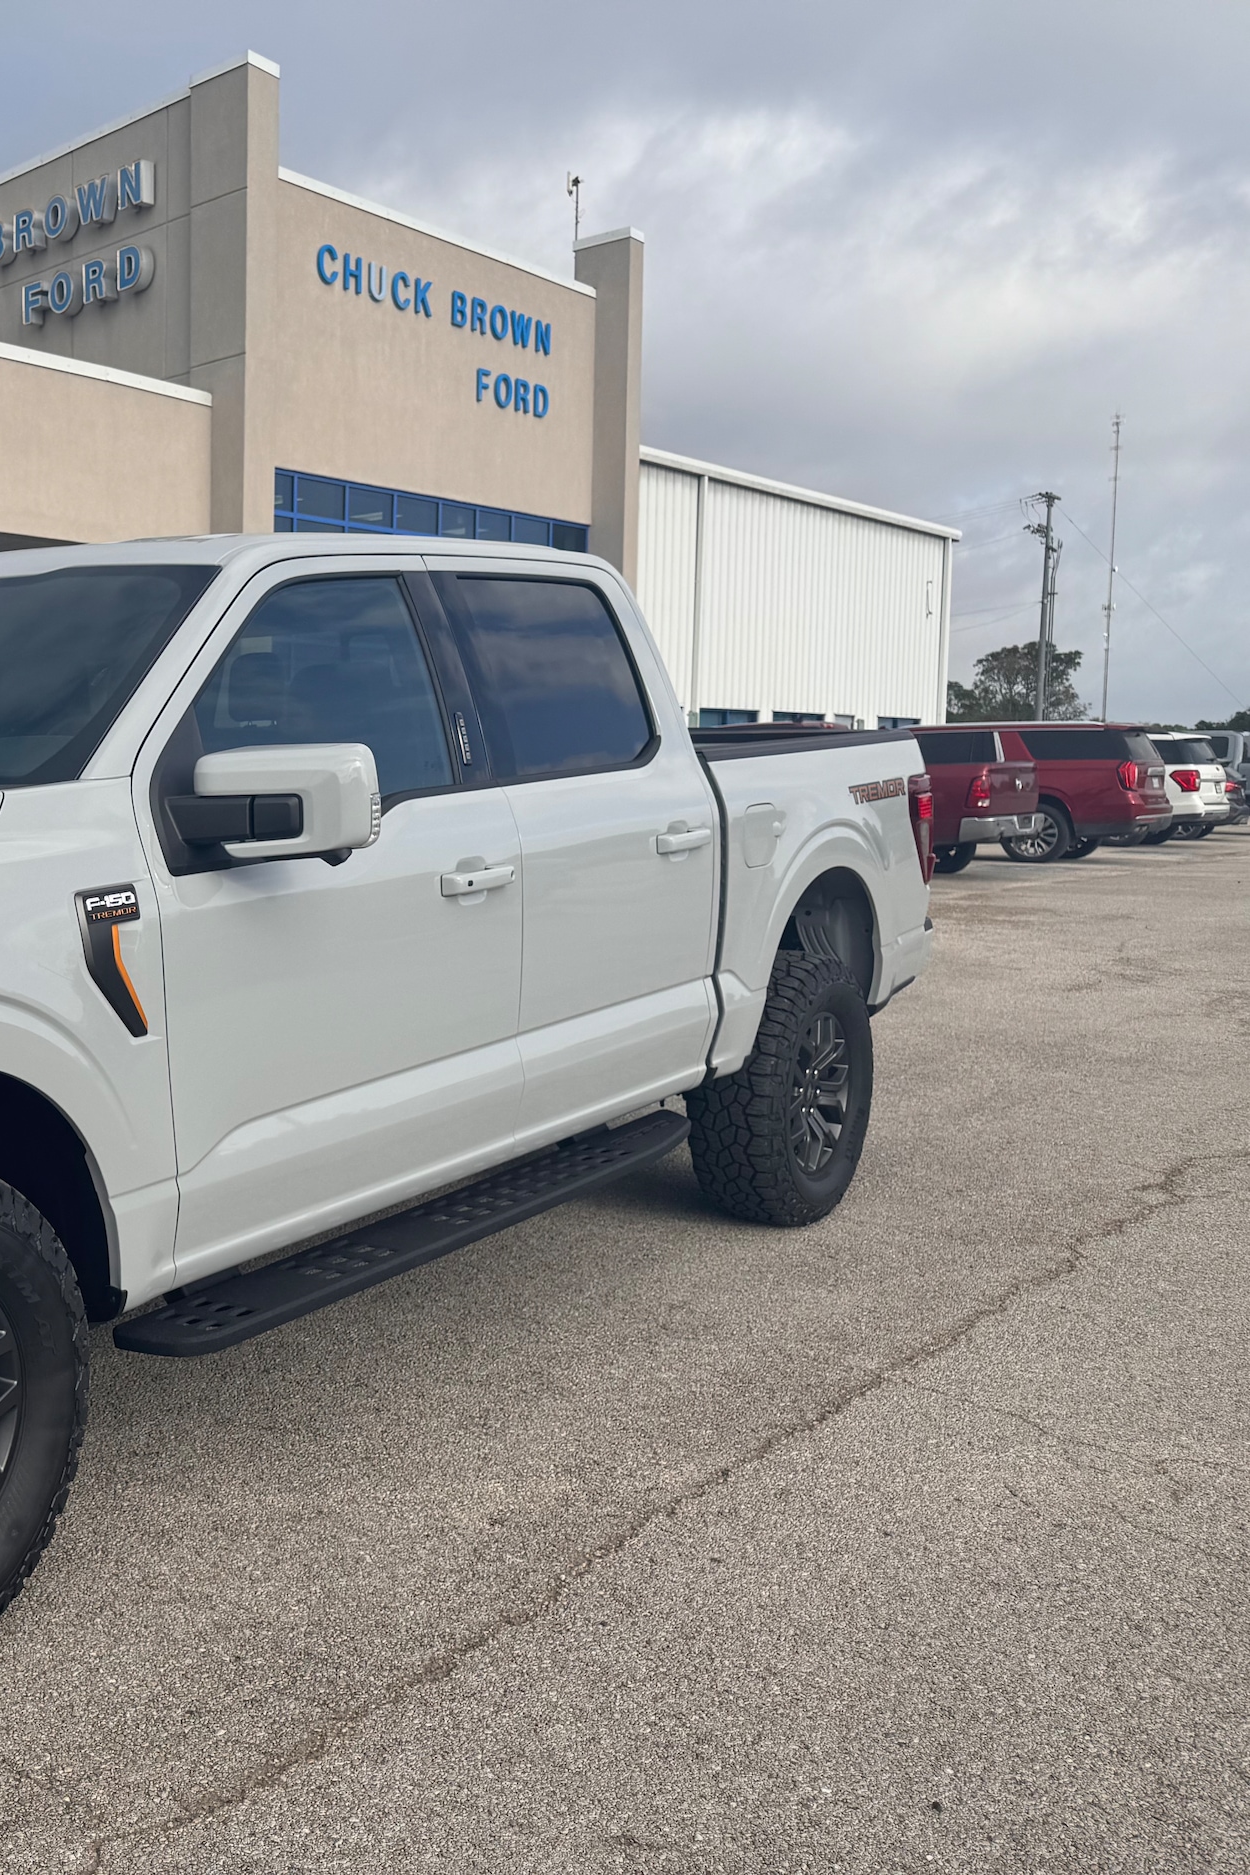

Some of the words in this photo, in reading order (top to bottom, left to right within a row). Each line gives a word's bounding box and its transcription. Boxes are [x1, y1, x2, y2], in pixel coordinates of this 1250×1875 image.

[21, 244, 153, 325] FORD
[316, 243, 432, 318] CHUCK
[451, 290, 552, 357] BROWN
[476, 366, 550, 418] FORD
[848, 777, 906, 805] TREMOR
[85, 891, 136, 911] F-150
[89, 906, 137, 921] TREMOR
